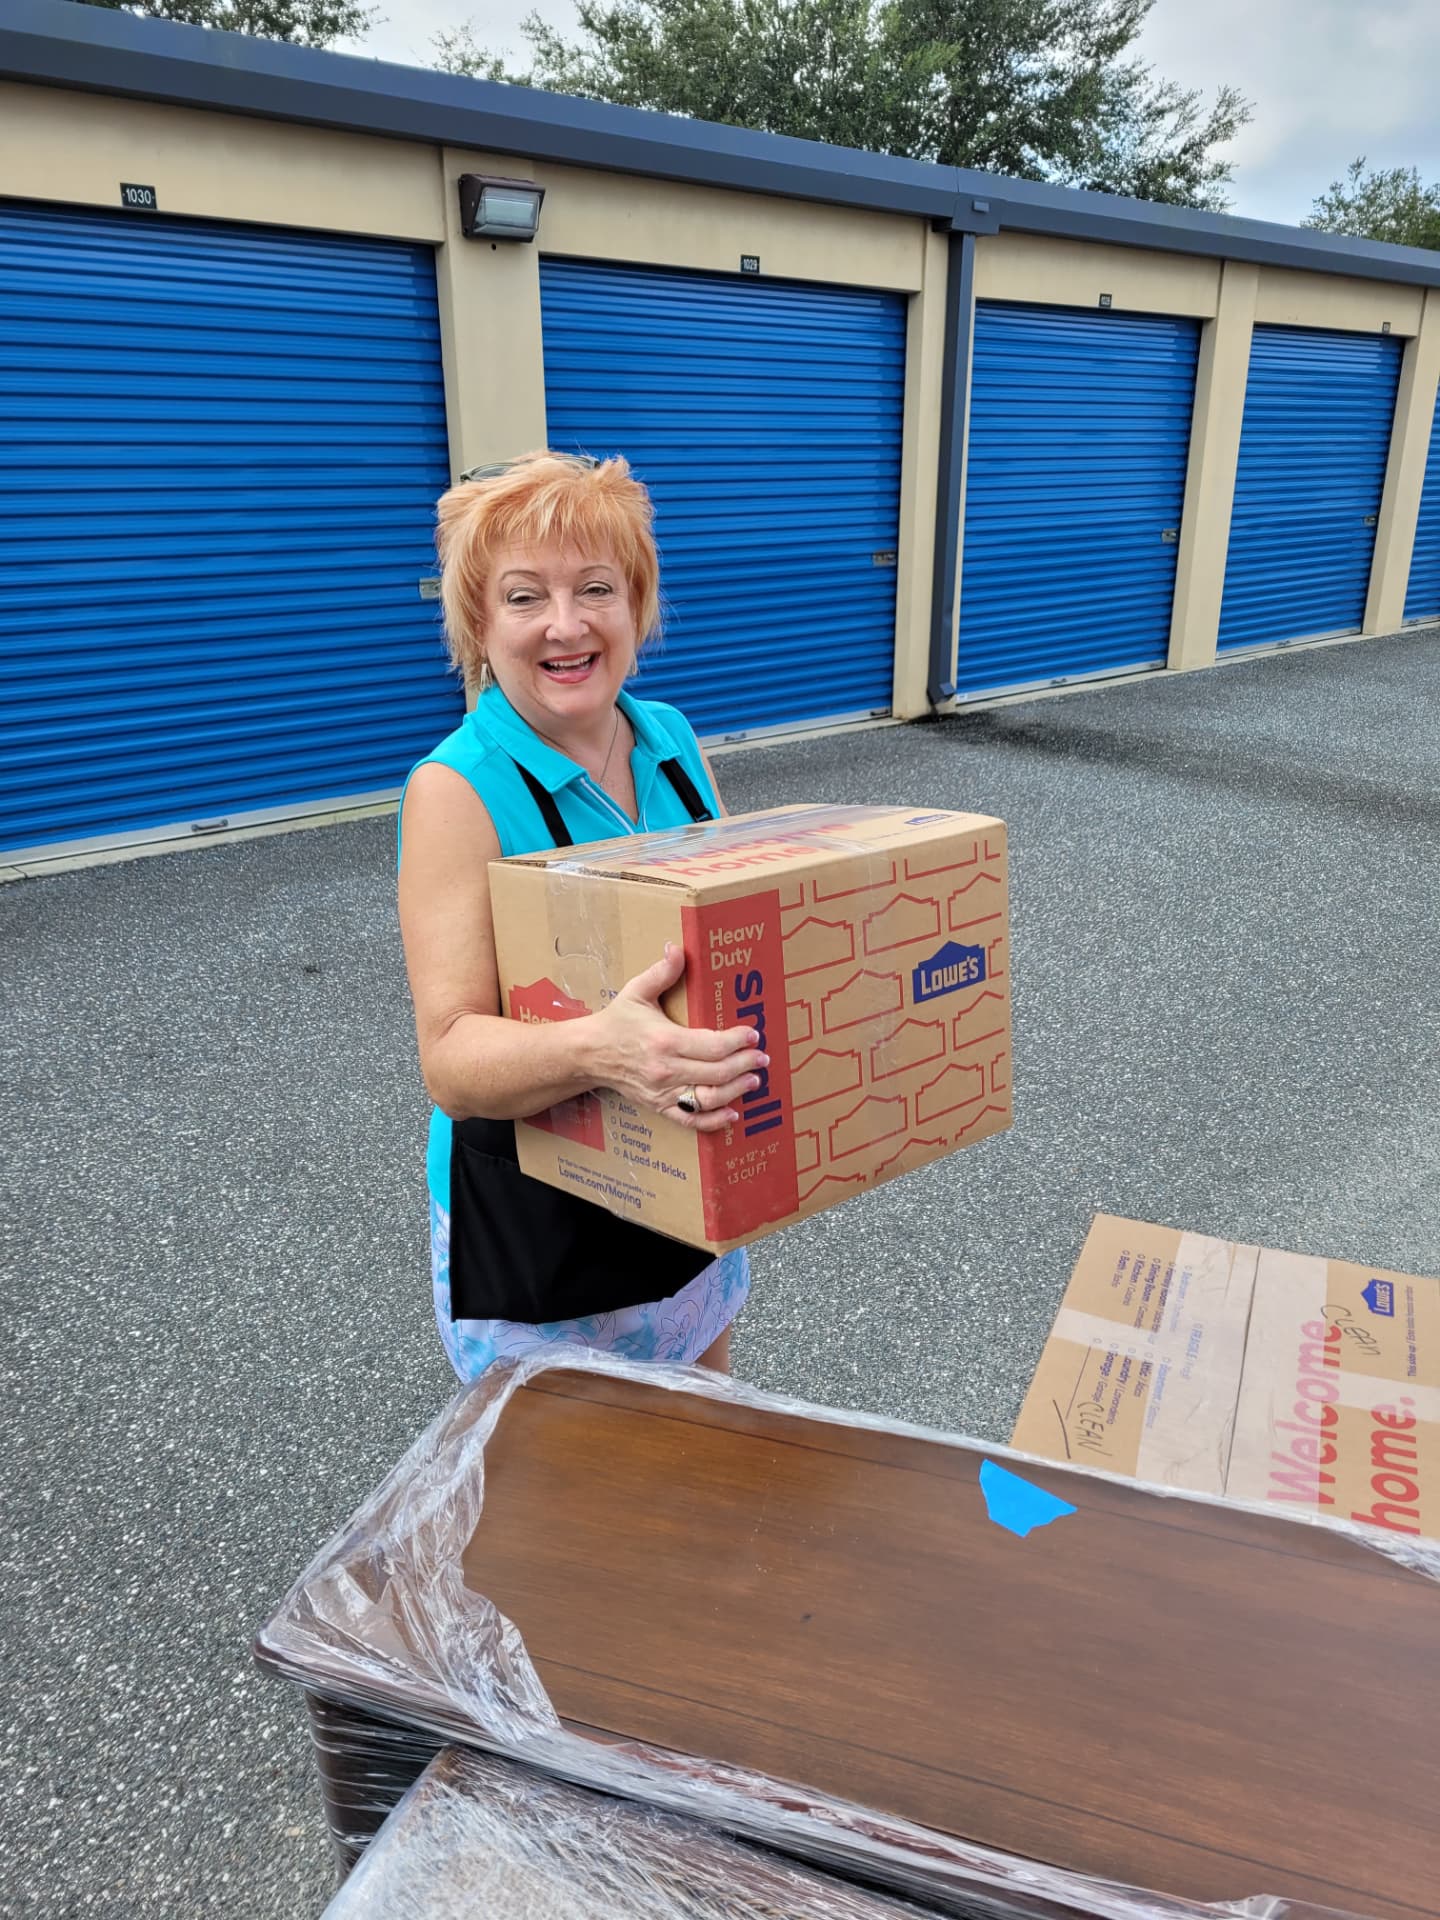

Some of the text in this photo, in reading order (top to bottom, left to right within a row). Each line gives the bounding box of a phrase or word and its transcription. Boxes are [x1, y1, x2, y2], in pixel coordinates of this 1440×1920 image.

[126, 188, 151, 204] 1030
[622, 823, 852, 867] Welcome
[709, 922, 765, 949] Heavy
[711, 947, 752, 971] Duty
[920, 956, 979, 996] LOWE'S
[714, 980, 724, 1012] Para
[618, 1102, 638, 1117] Attic
[619, 1117, 653, 1139] Laundry
[620, 1133, 652, 1153] Garage
[623, 1149, 687, 1181] A Load of Bricks
[745, 1149, 759, 1162] 12"
[727, 1161, 768, 1184] 1.3 CU FT
[559, 1164, 641, 1208] Lowes.com/Moving
[1117, 1255, 1130, 1271] Bath
[1130, 1259, 1145, 1283] Kitchen
[1145, 1263, 1160, 1283] Dining
[1142, 1283, 1155, 1302] Room
[1267, 1320, 1342, 1504] Welcome
[1074, 1401, 1113, 1457] CLEAN
[1351, 1396, 1420, 1535] home.
